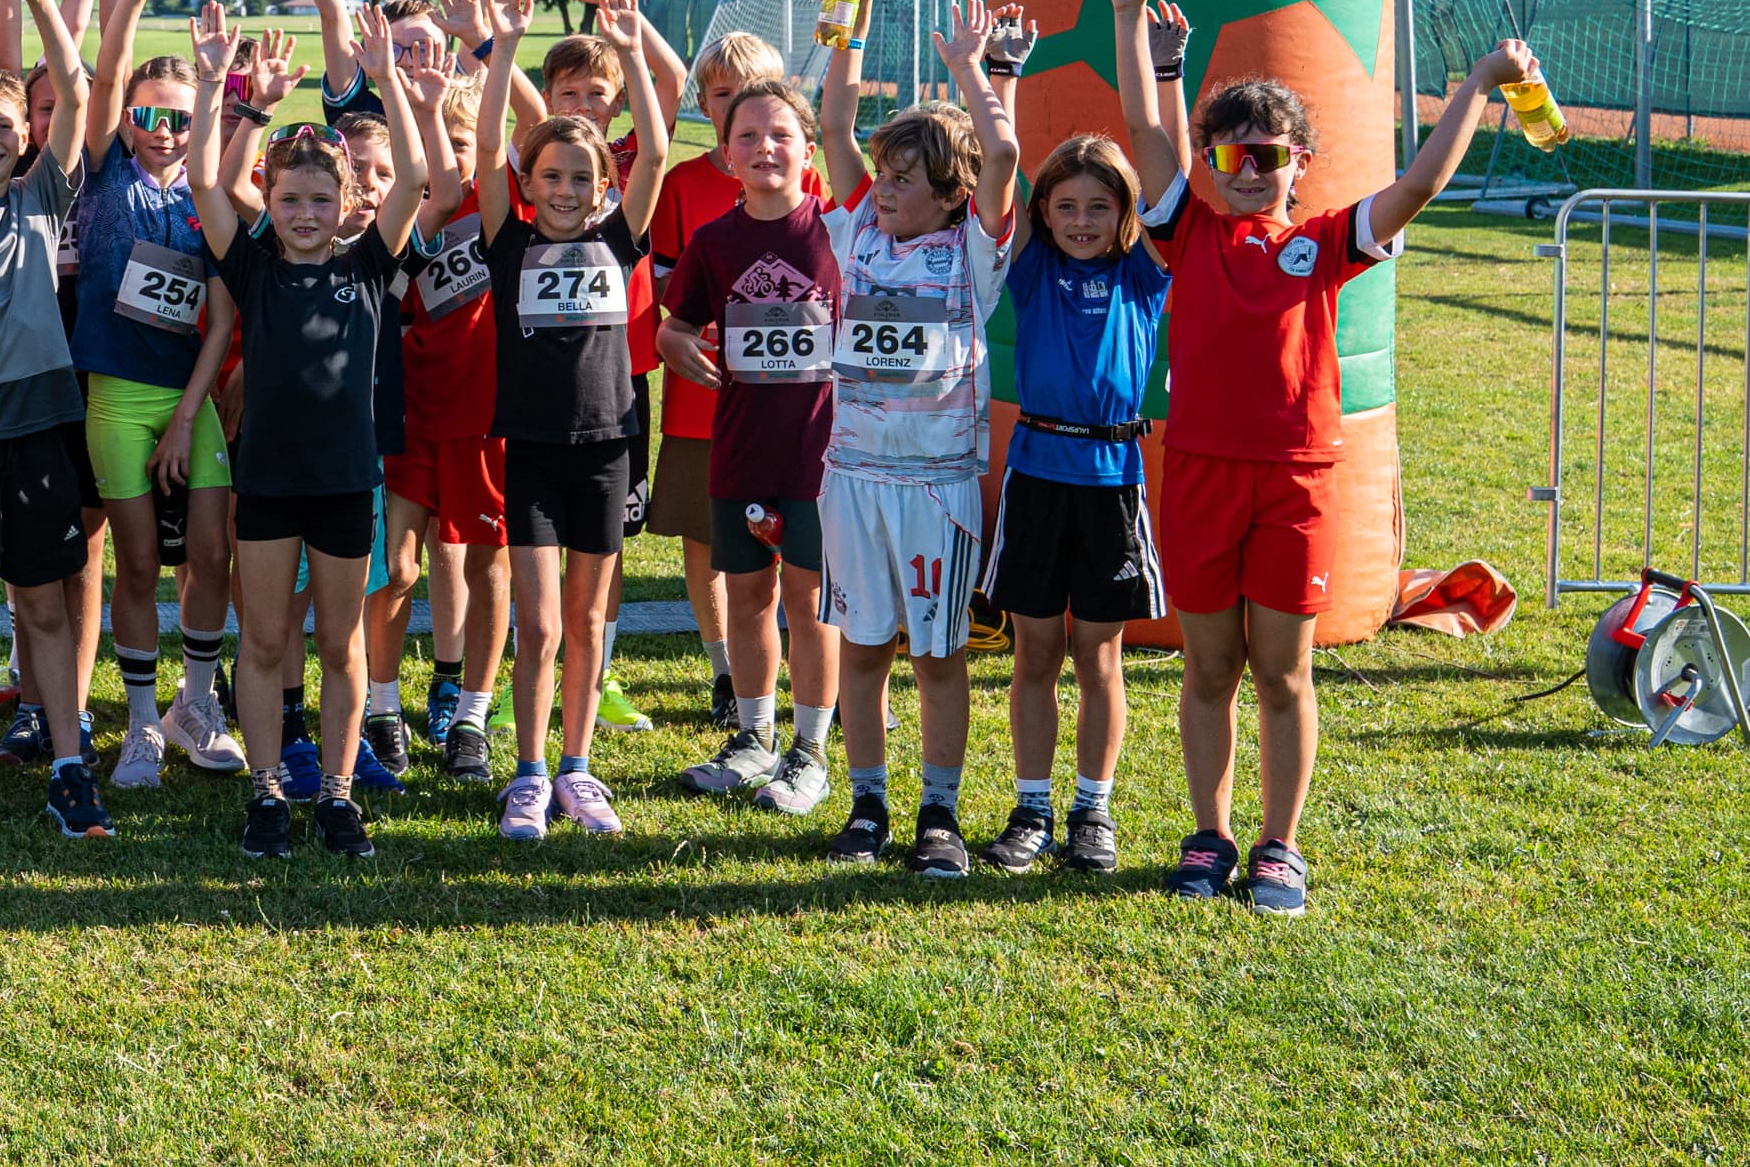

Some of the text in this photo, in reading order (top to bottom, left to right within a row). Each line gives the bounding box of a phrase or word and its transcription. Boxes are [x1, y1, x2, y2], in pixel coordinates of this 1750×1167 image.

[139, 271, 201, 311] 254
[451, 269, 487, 294] LAURIN
[537, 270, 611, 300] 274
[157, 305, 181, 318] LENA
[558, 302, 593, 311] BELLA
[742, 329, 814, 357] 266
[852, 324, 928, 355] 264
[761, 360, 796, 369] LOTTA
[866, 356, 911, 367] LORENZ
